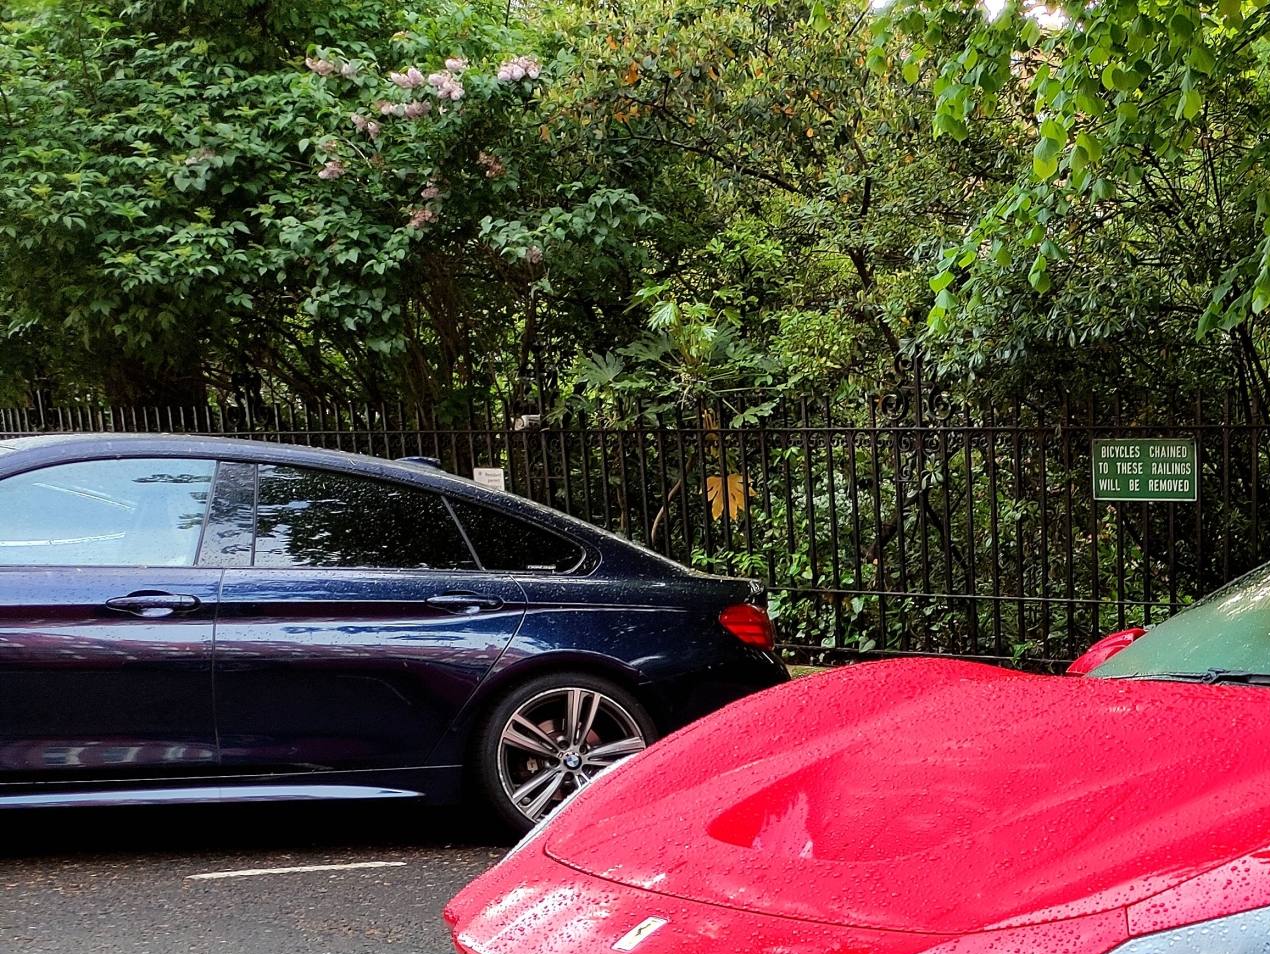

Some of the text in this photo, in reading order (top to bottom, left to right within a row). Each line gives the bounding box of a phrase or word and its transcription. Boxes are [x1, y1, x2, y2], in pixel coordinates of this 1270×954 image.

[1101, 445, 1187, 458] BICYCLES CHAINED
[1098, 462, 1191, 475] TO THESE RAILINGS
[1098, 479, 1190, 492] WILL BE REMOVED
